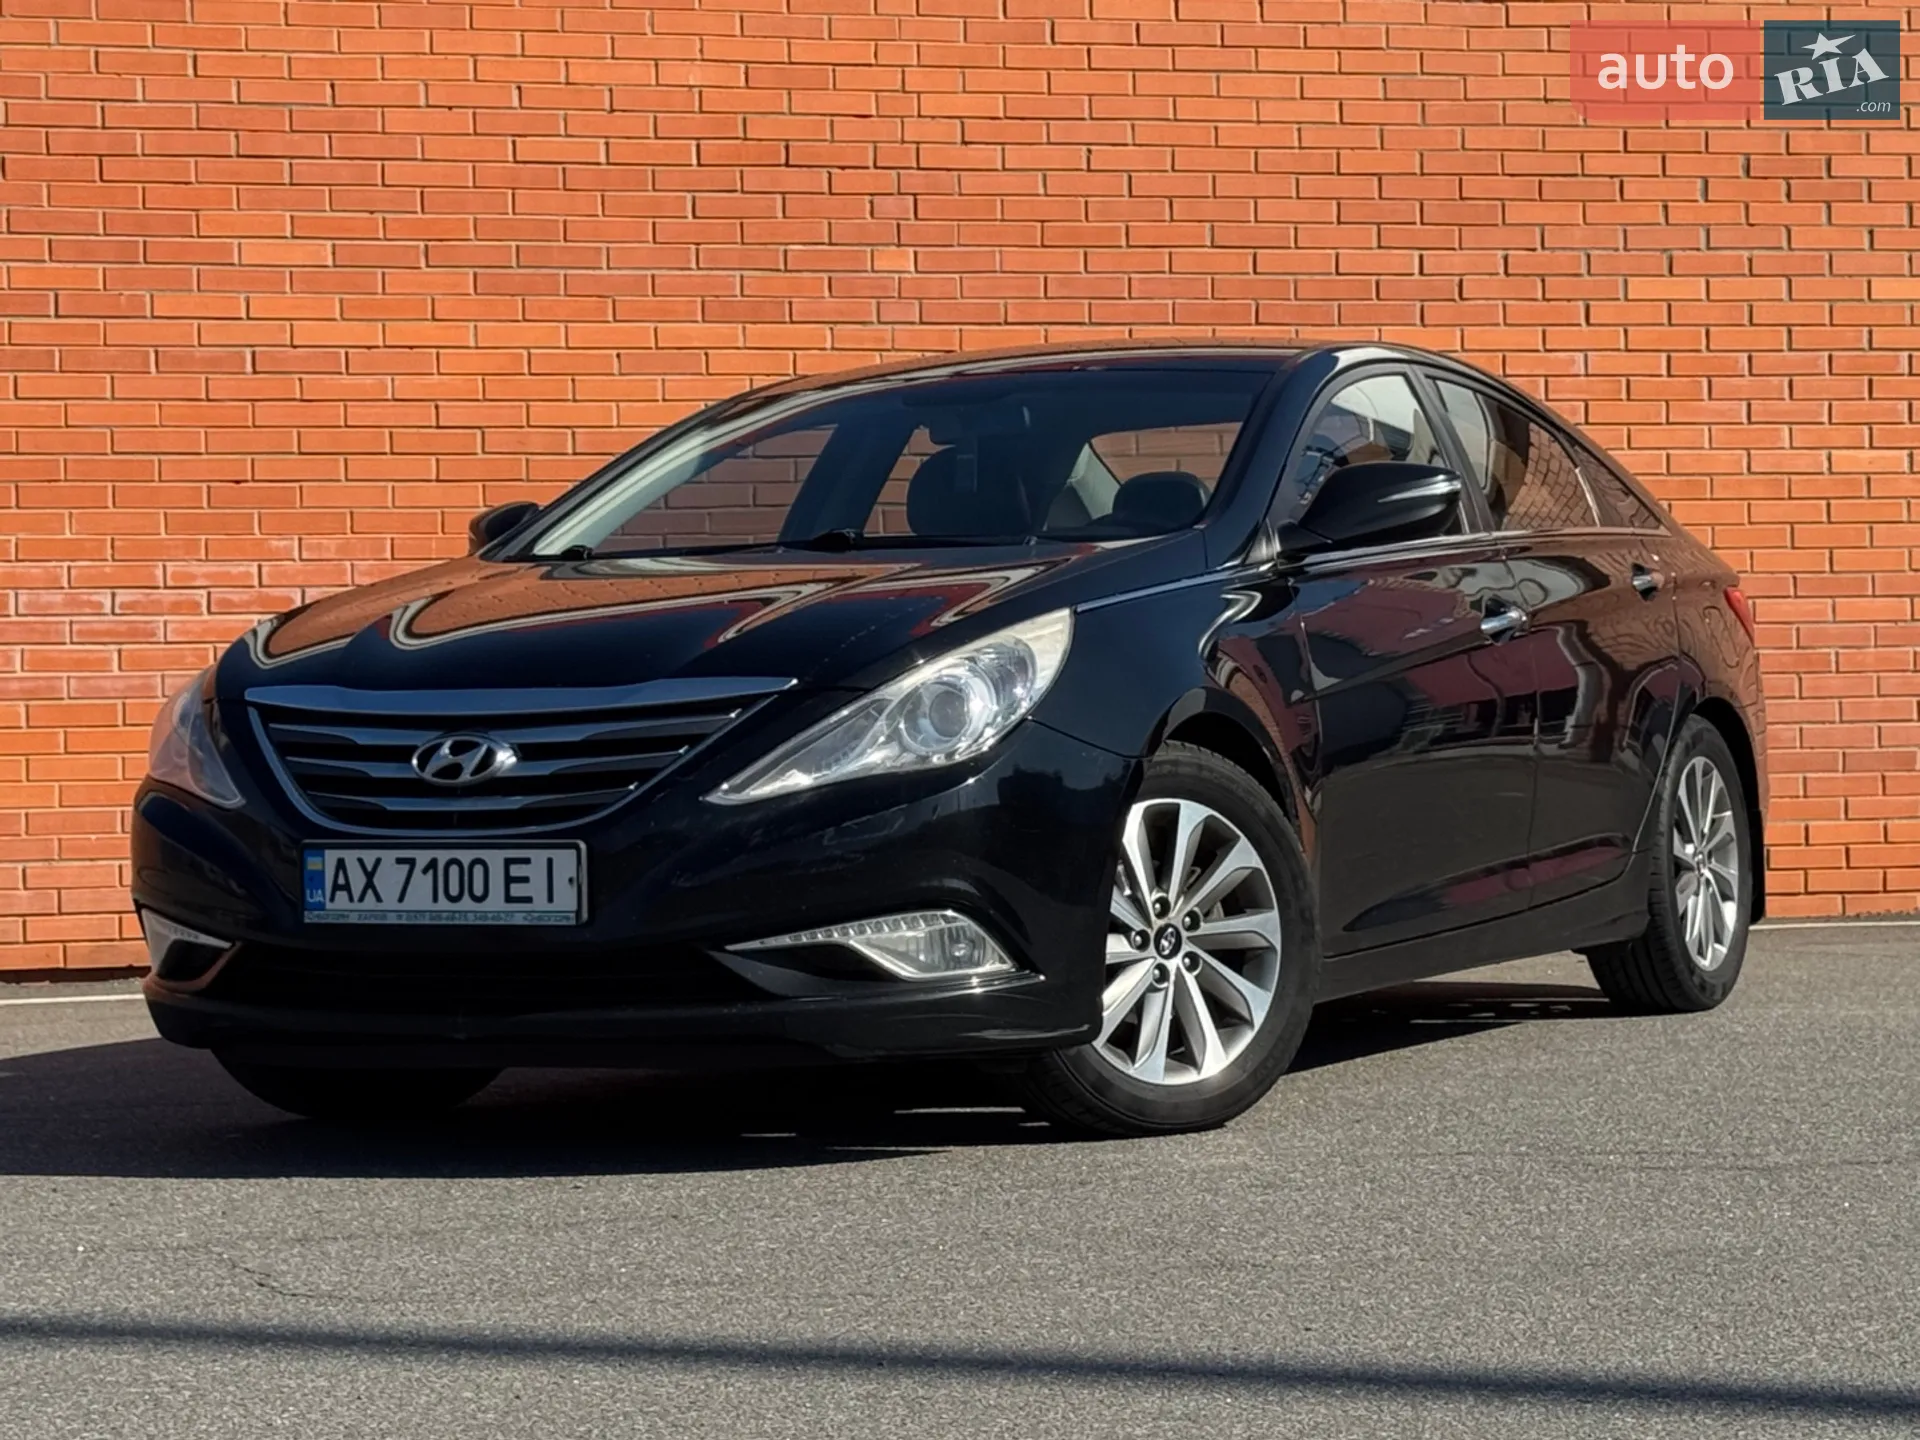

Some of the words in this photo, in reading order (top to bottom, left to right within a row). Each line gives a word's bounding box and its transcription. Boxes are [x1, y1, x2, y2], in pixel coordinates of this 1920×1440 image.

[306, 888, 325, 903] UA
[329, 857, 384, 904] AX
[394, 857, 490, 904] 7100
[503, 857, 555, 904] EI
